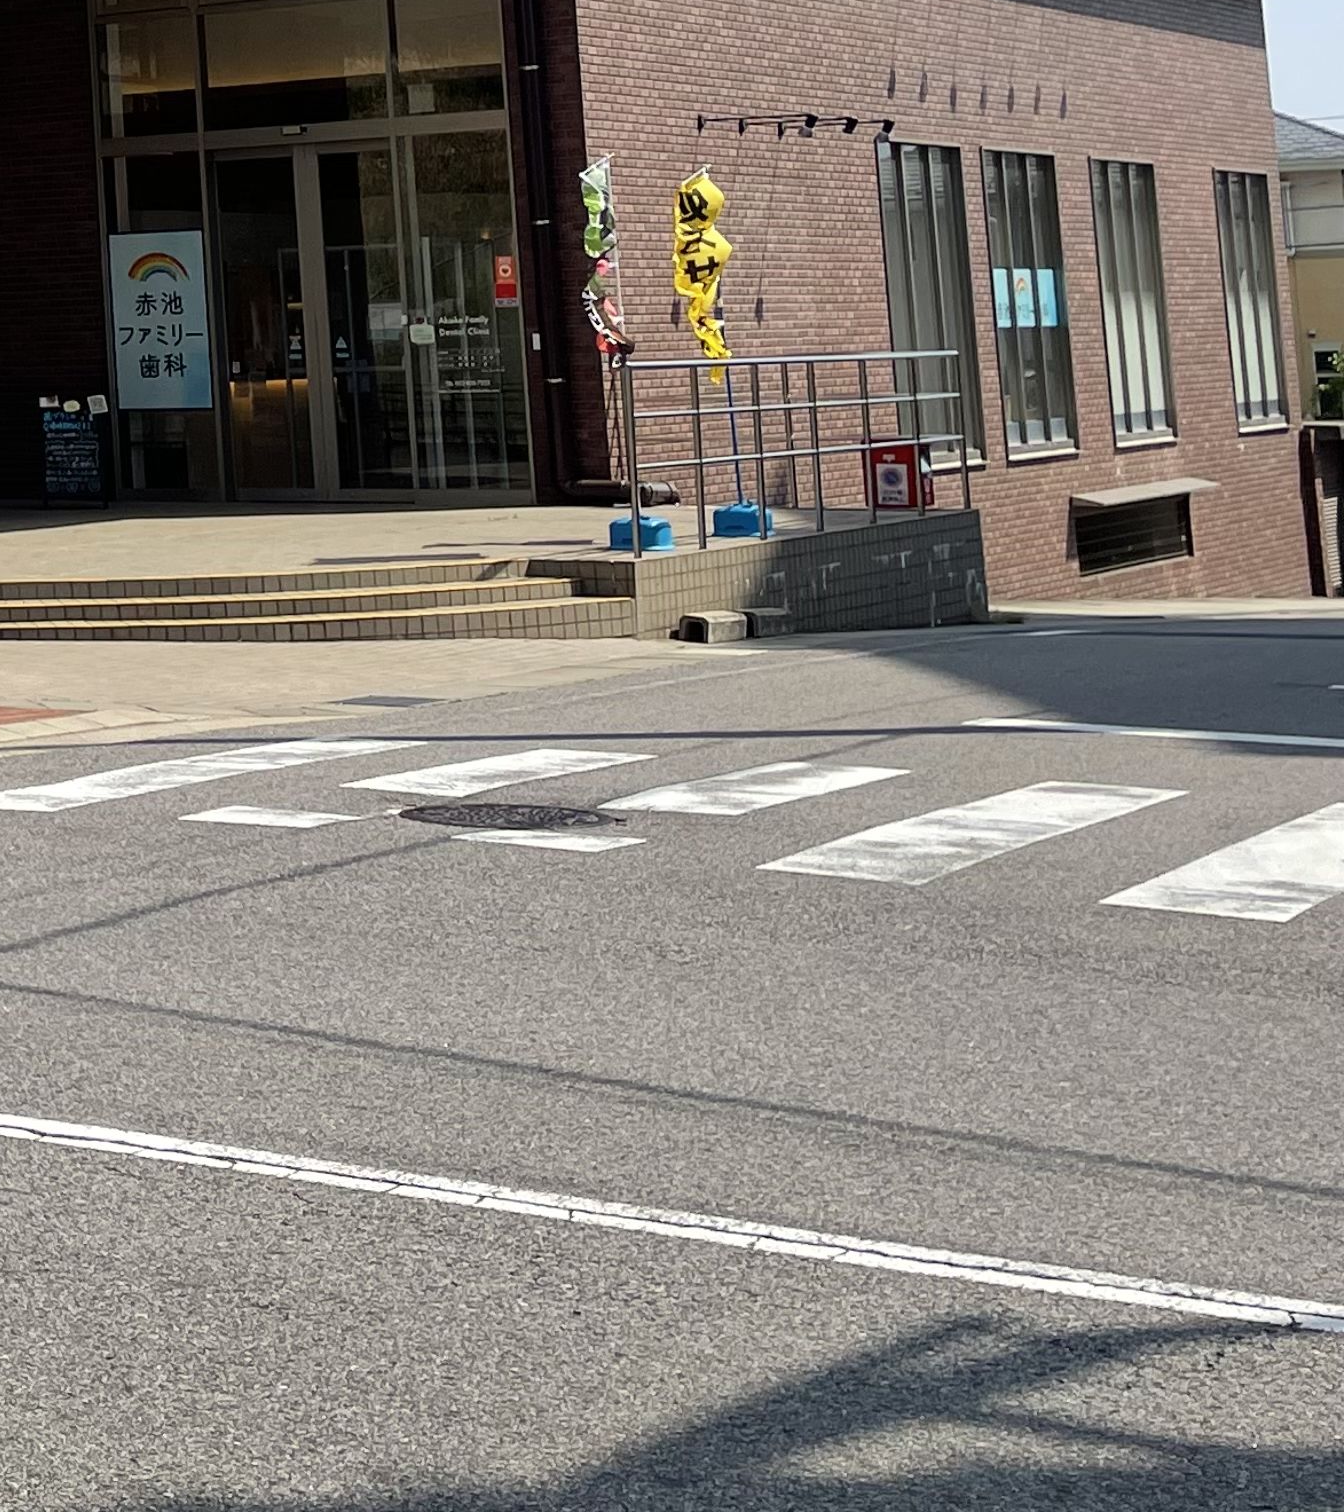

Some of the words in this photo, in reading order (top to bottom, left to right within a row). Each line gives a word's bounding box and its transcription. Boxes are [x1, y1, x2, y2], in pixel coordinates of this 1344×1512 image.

[135, 291, 184, 316] 赤池
[119, 323, 204, 346] ファミリー
[139, 353, 187, 378] 歯科
